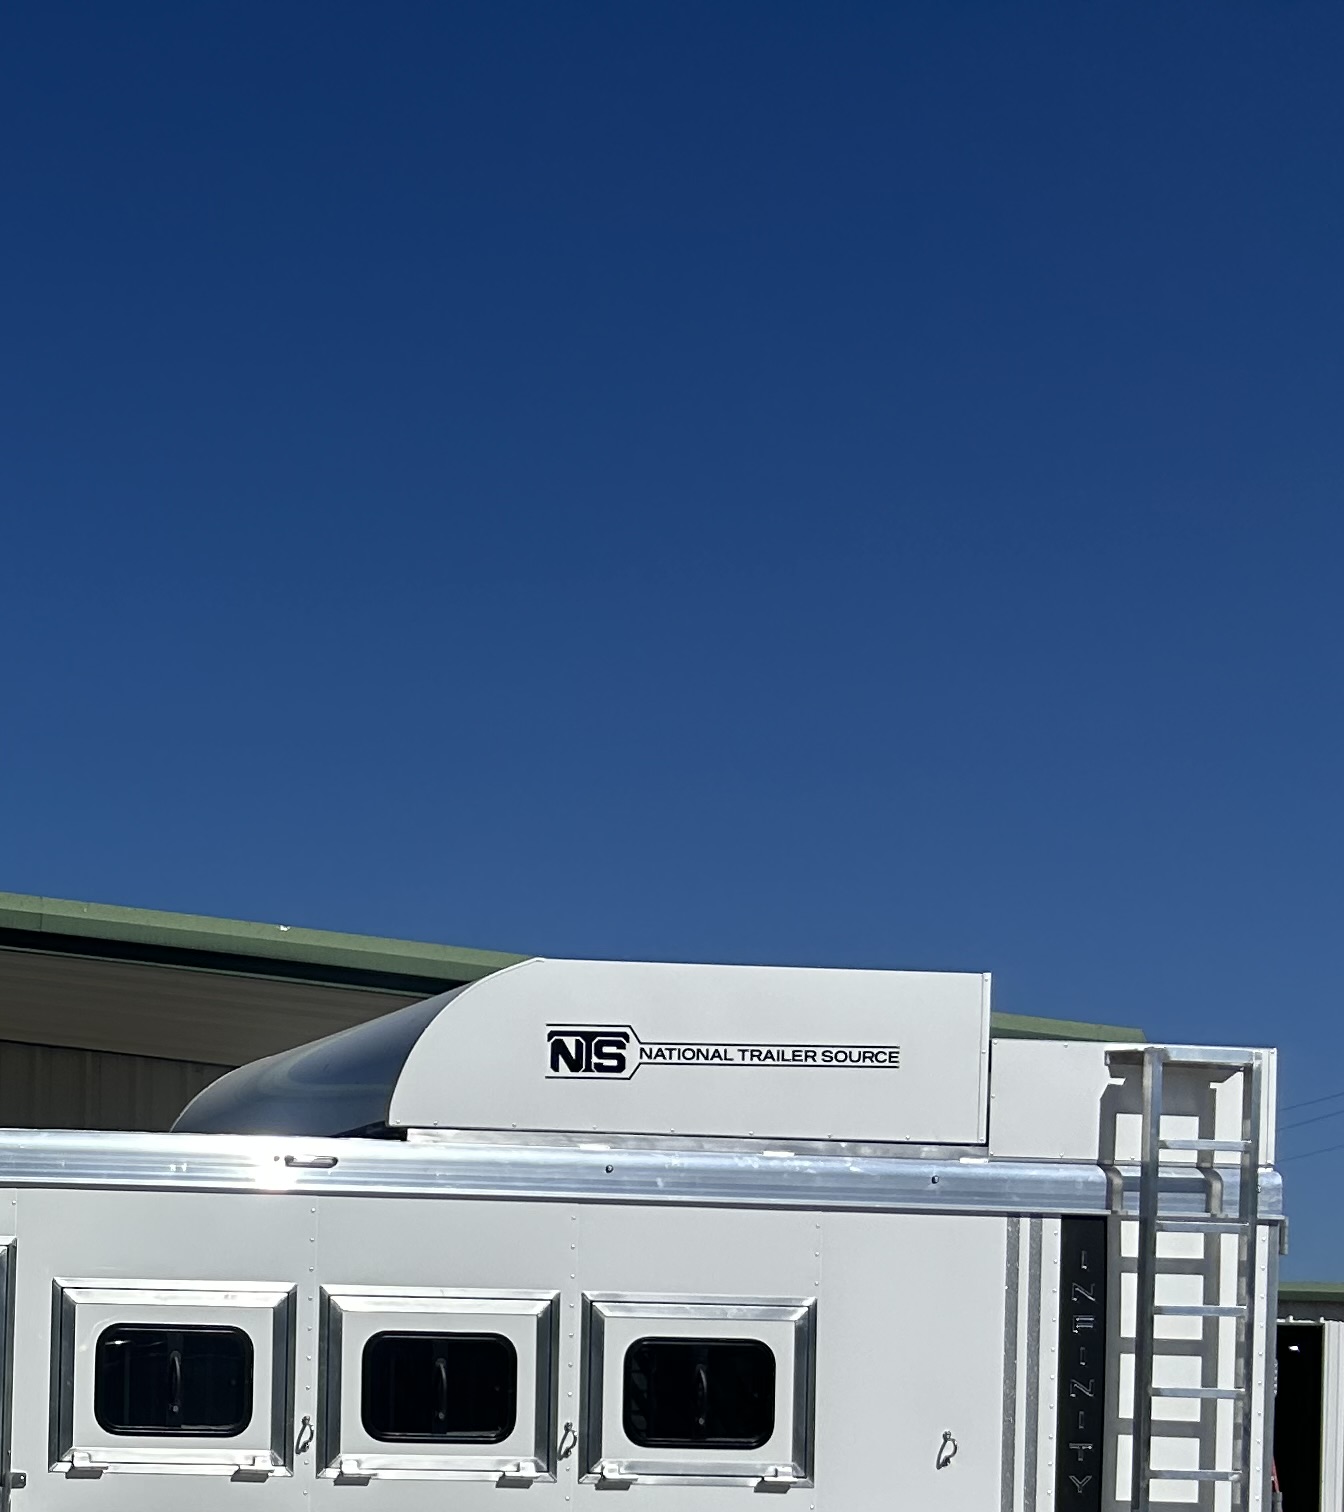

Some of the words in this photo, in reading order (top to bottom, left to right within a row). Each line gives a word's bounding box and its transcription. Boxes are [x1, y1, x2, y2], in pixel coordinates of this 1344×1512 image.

[547, 1031, 630, 1073] NTS
[639, 1047, 734, 1062] NATIONAL
[737, 1048, 817, 1063] TRAILER
[821, 1050, 900, 1064] SOURCE
[1069, 1250, 1096, 1493] INFINITY
